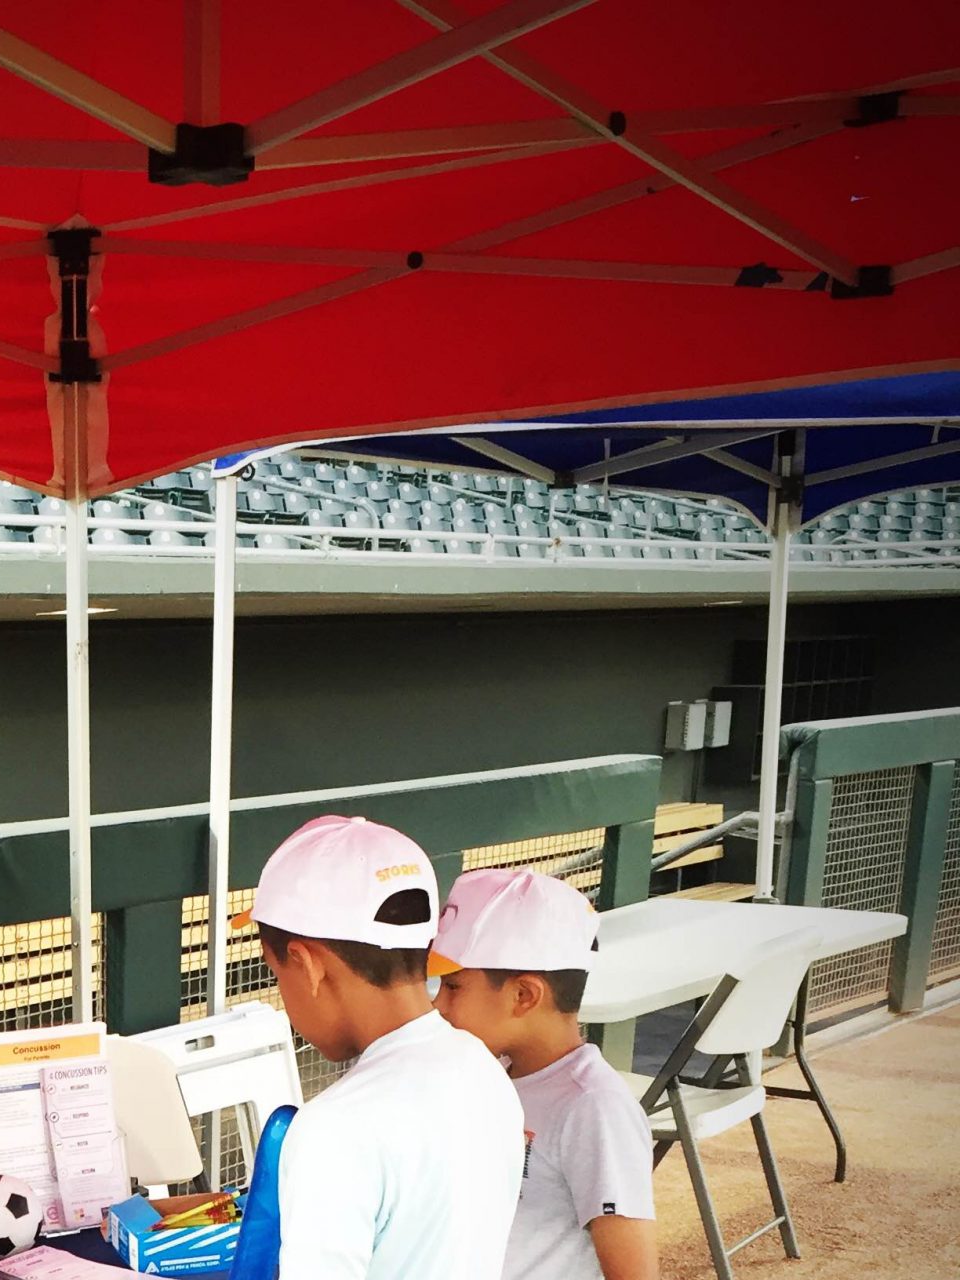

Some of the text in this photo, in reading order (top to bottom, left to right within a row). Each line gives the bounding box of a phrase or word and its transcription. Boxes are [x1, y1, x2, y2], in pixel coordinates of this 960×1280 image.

[12, 1043, 61, 1055] Concussion
[54, 1067, 93, 1080] CONCUSSION
[93, 1065, 107, 1076] TIPS
